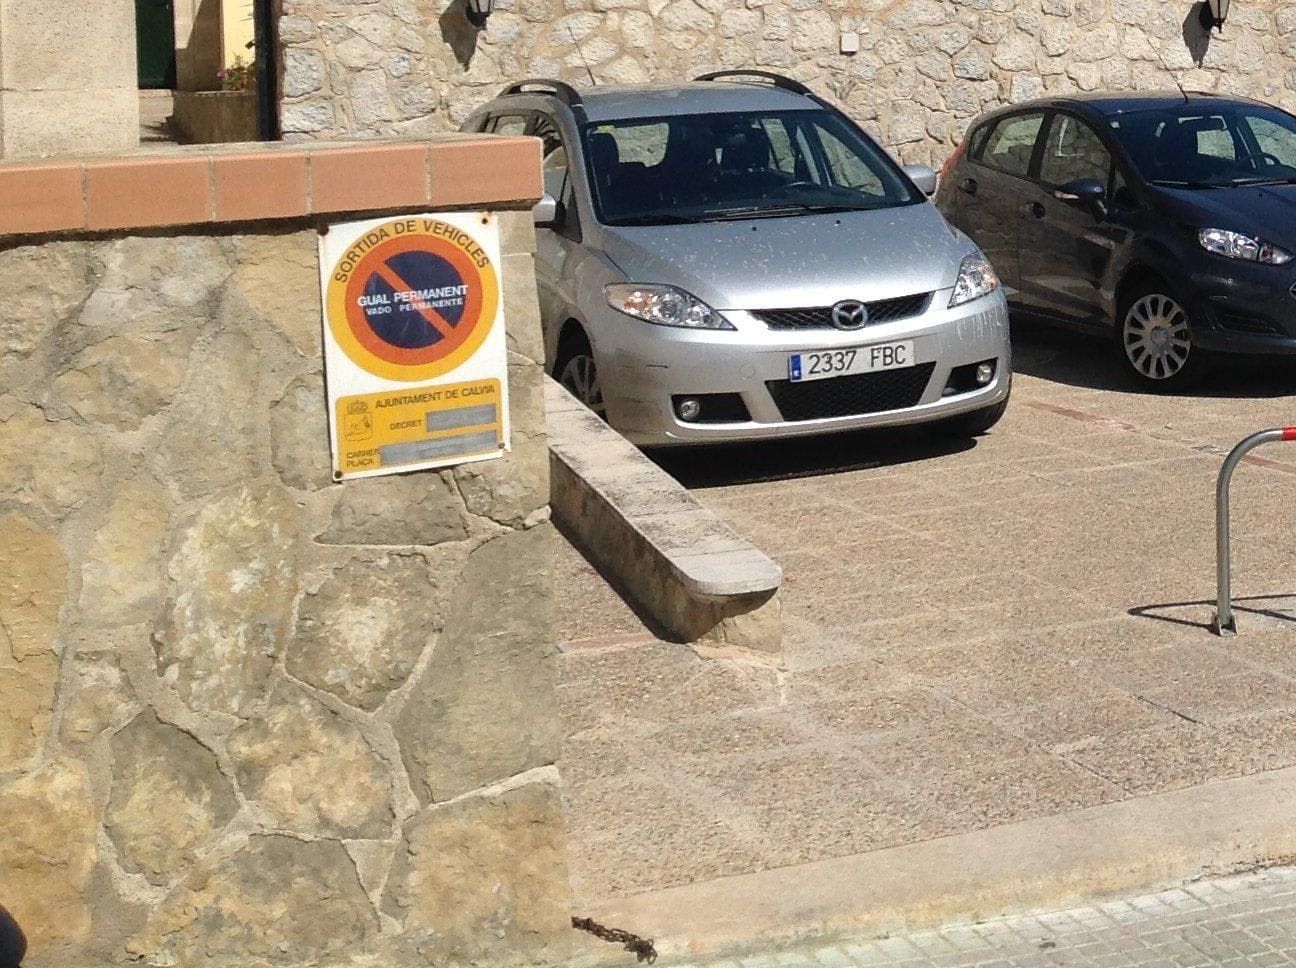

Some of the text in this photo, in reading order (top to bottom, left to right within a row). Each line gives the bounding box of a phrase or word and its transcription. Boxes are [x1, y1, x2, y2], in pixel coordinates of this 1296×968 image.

[335, 220, 490, 283] SORTIDA DE VEHICLES
[357, 284, 469, 307] GUAL PERMANENT
[366, 298, 463, 316] VADO PERMANENTE
[808, 344, 906, 375] 2337 FBC
[375, 391, 443, 409] AJUNTAMENT
[445, 389, 458, 399] DE
